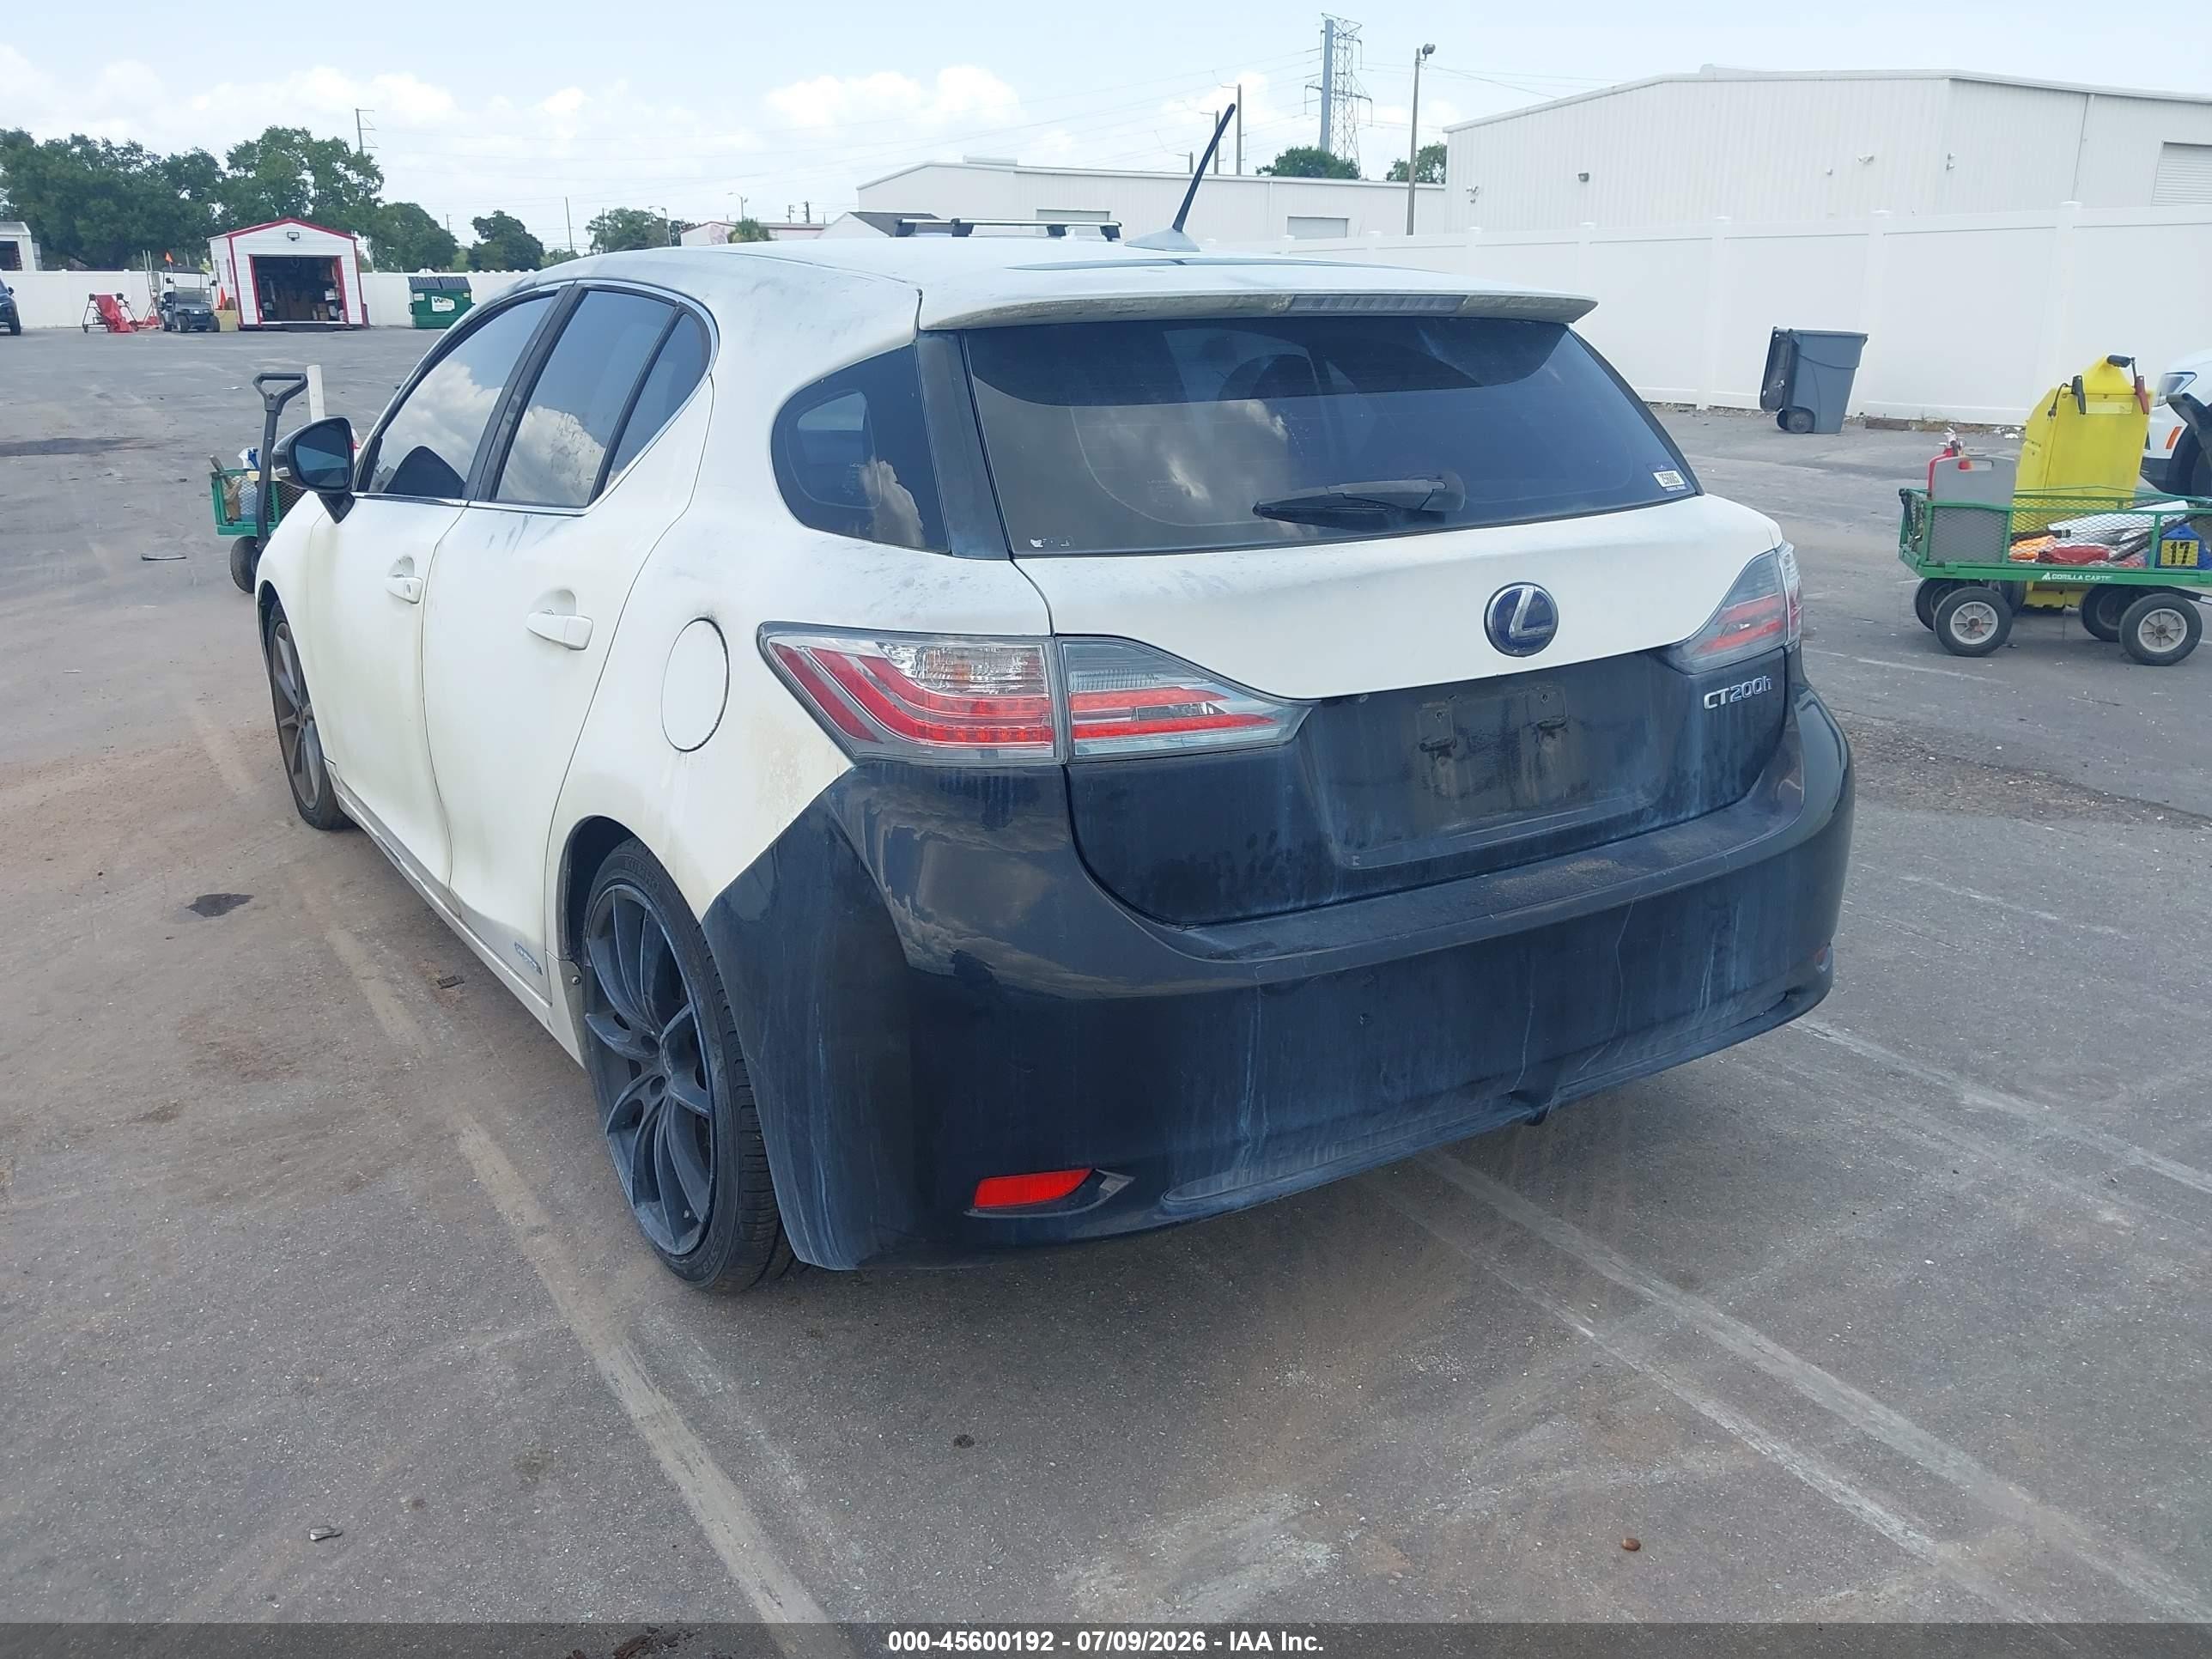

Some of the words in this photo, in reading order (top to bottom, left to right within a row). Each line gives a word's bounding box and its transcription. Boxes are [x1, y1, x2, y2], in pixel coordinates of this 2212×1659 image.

[2170, 541, 2191, 565] 17
[2051, 573, 2083, 581] GORILLA
[1704, 675, 1772, 710] CT200h
